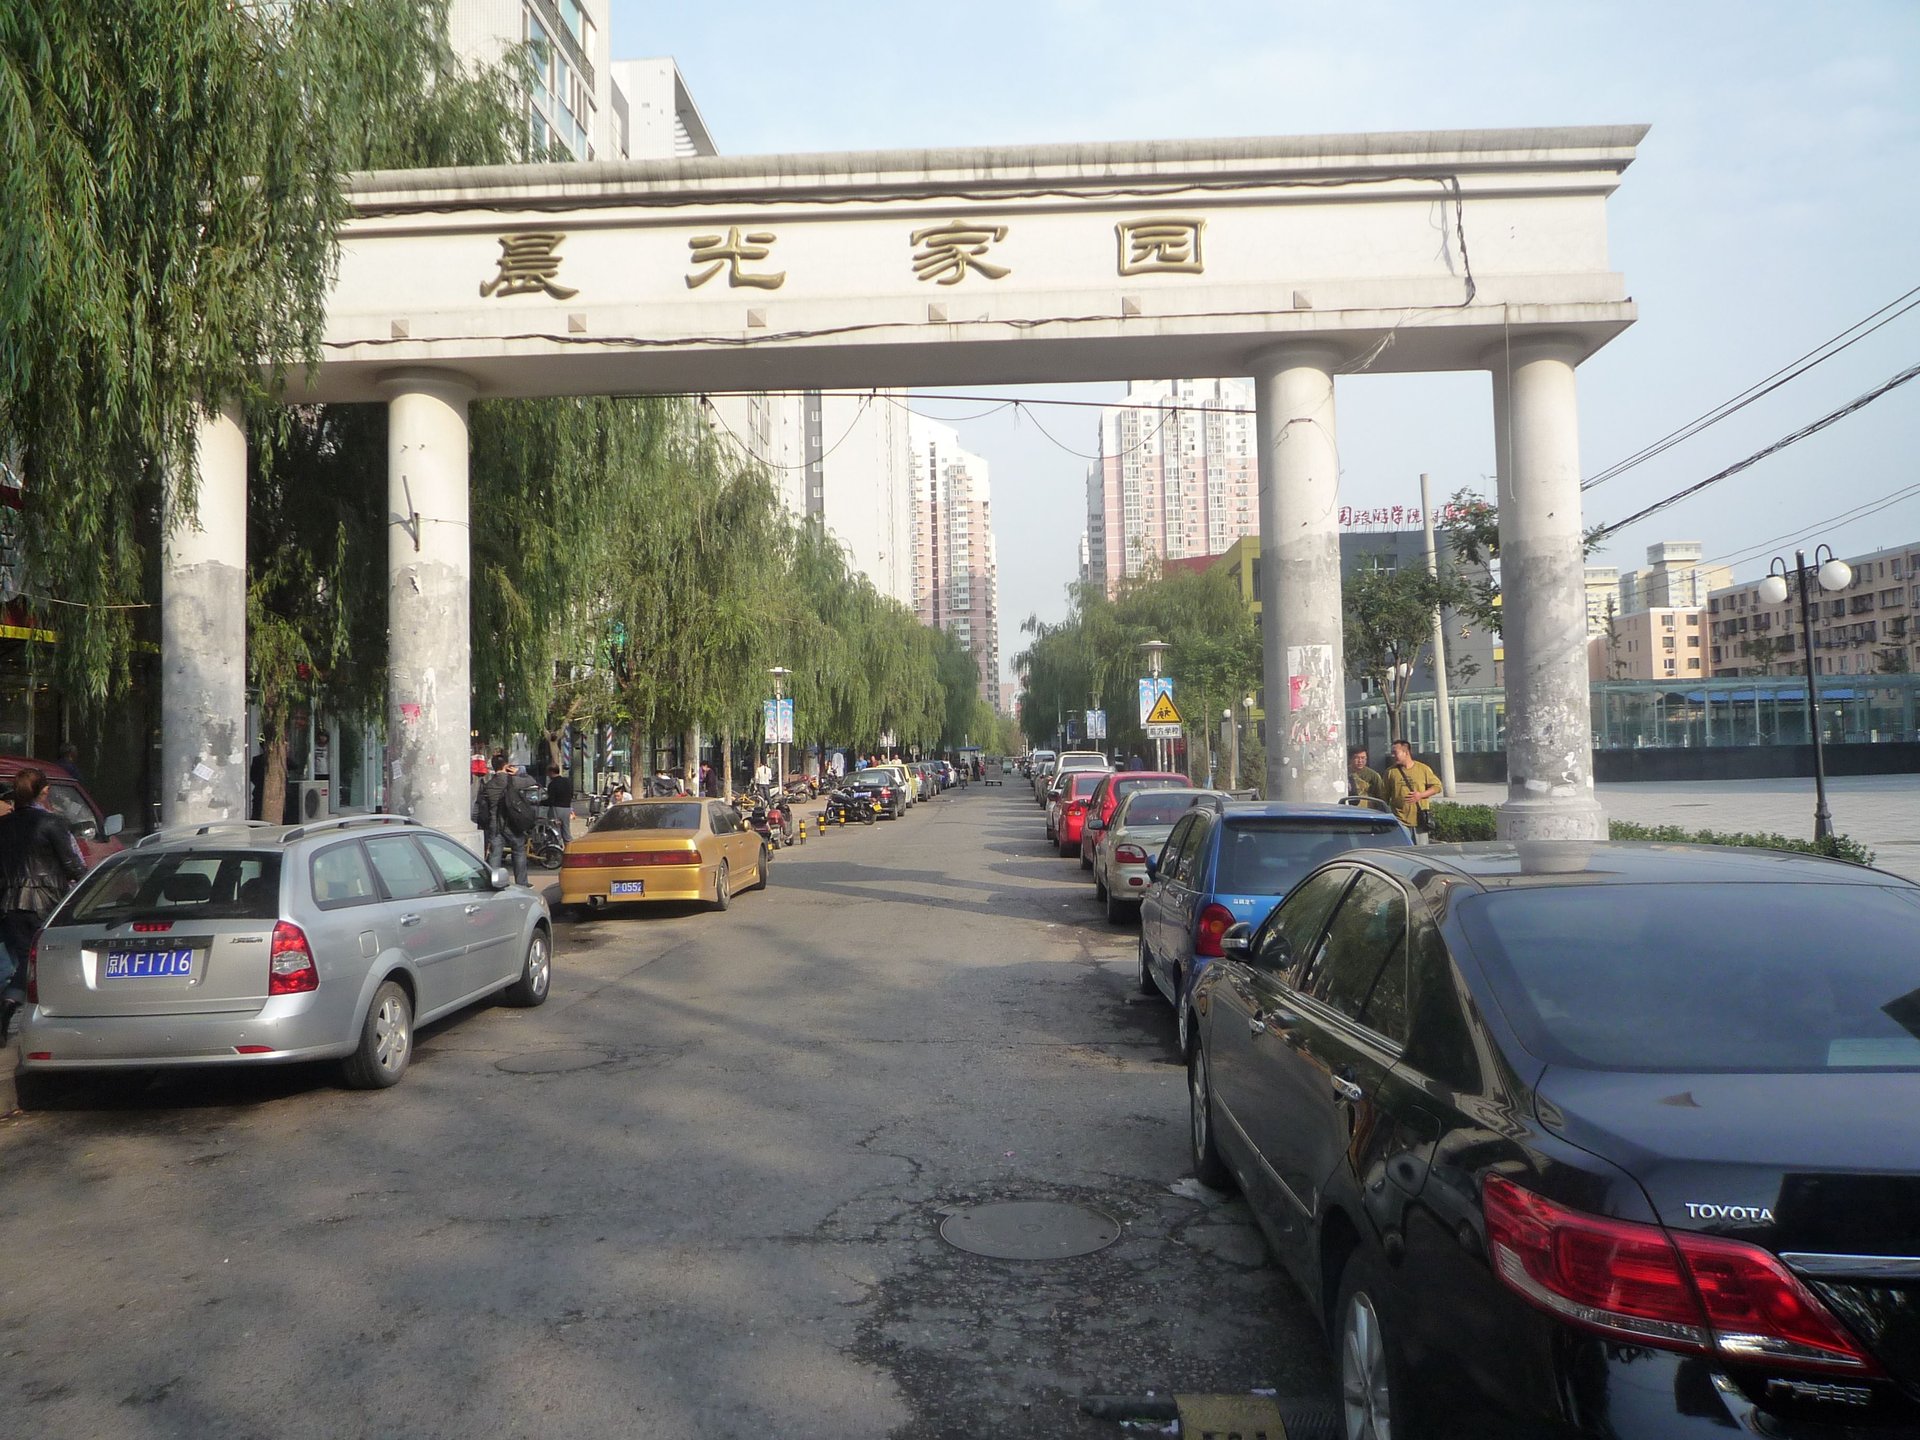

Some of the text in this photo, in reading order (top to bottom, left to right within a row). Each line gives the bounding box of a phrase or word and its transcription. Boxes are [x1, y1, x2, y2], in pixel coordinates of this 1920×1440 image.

[480, 216, 1206, 300] 晨光家园
[1685, 1202, 1776, 1224] TOYOTA
